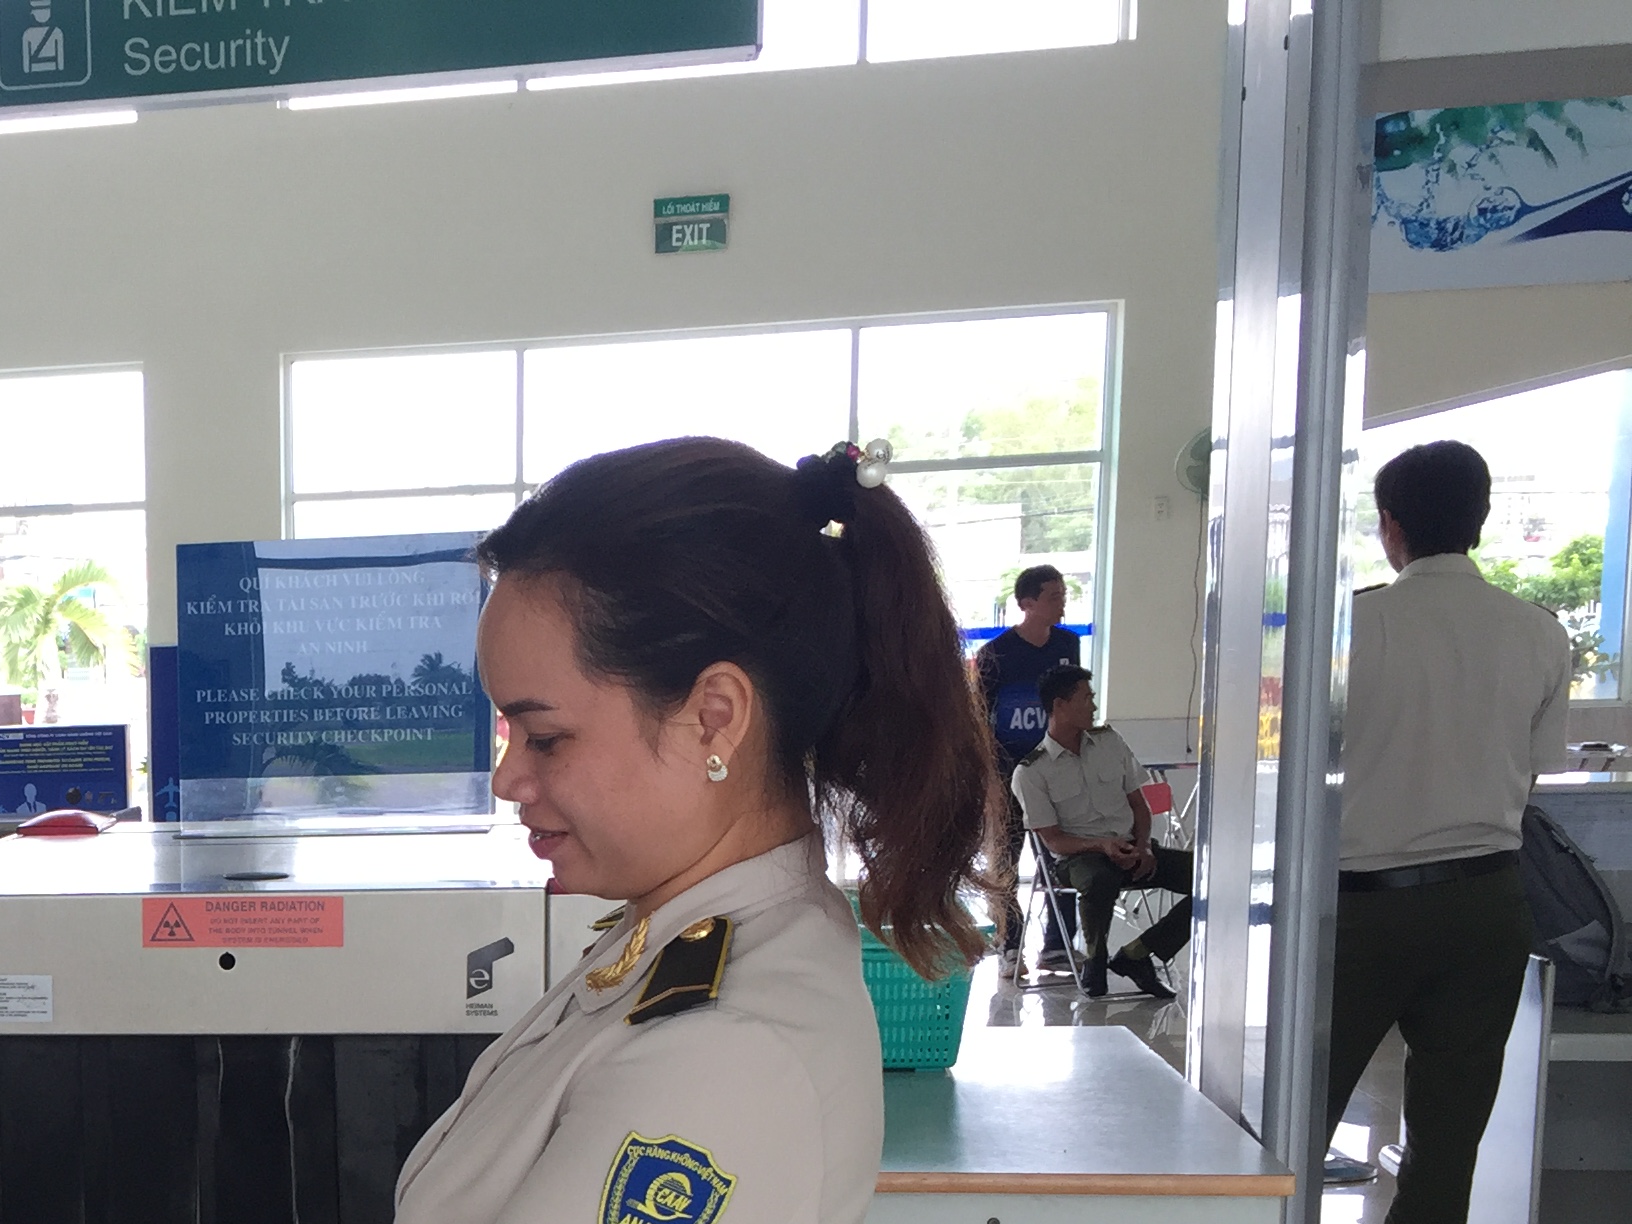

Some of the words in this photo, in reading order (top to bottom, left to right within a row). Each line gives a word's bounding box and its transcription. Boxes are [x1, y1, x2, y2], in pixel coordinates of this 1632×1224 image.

[123, 28, 290, 76] Security
[672, 223, 711, 247] EXIT
[187, 594, 233, 615] KIỂM
[237, 598, 272, 613] TRA
[272, 620, 308, 634] KHU
[408, 616, 442, 629] TRA
[326, 640, 368, 654] NINH
[196, 688, 260, 703] PLEASE
[265, 686, 324, 700] CHECK
[330, 684, 376, 699] YOUR
[381, 681, 473, 697] PERSONAL
[204, 708, 309, 724] PROPERTIES
[313, 706, 381, 721] BEFORE
[386, 704, 463, 720] LEAVING
[1009, 707, 1047, 730] ACV
[232, 730, 318, 746] SECURITY
[321, 727, 434, 744] CHECKPOINT
[205, 901, 256, 912] DANGER
[260, 900, 325, 912] RADIATION
